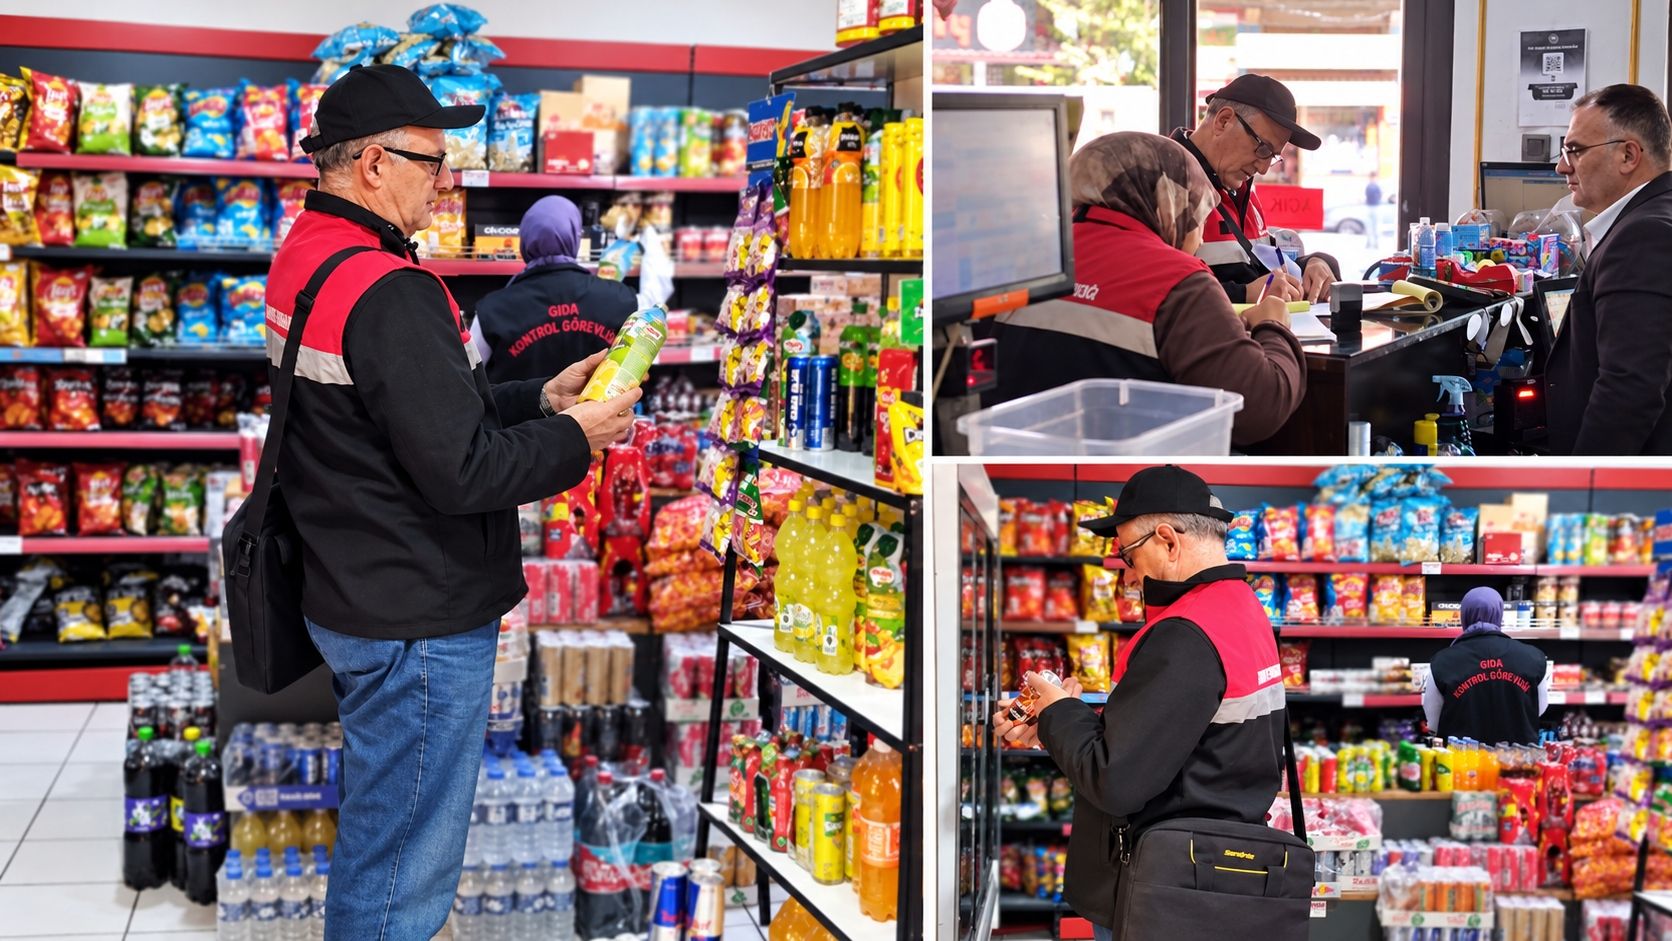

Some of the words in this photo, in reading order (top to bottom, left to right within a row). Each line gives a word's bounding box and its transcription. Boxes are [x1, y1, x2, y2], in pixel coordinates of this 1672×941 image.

[548, 303, 579, 317] GIDA
[508, 322, 560, 357] KONTROL
[562, 317, 617, 346] GÖREVLİS
[1480, 658, 1504, 670] GIDA
[1453, 672, 1490, 699] KONTROL
